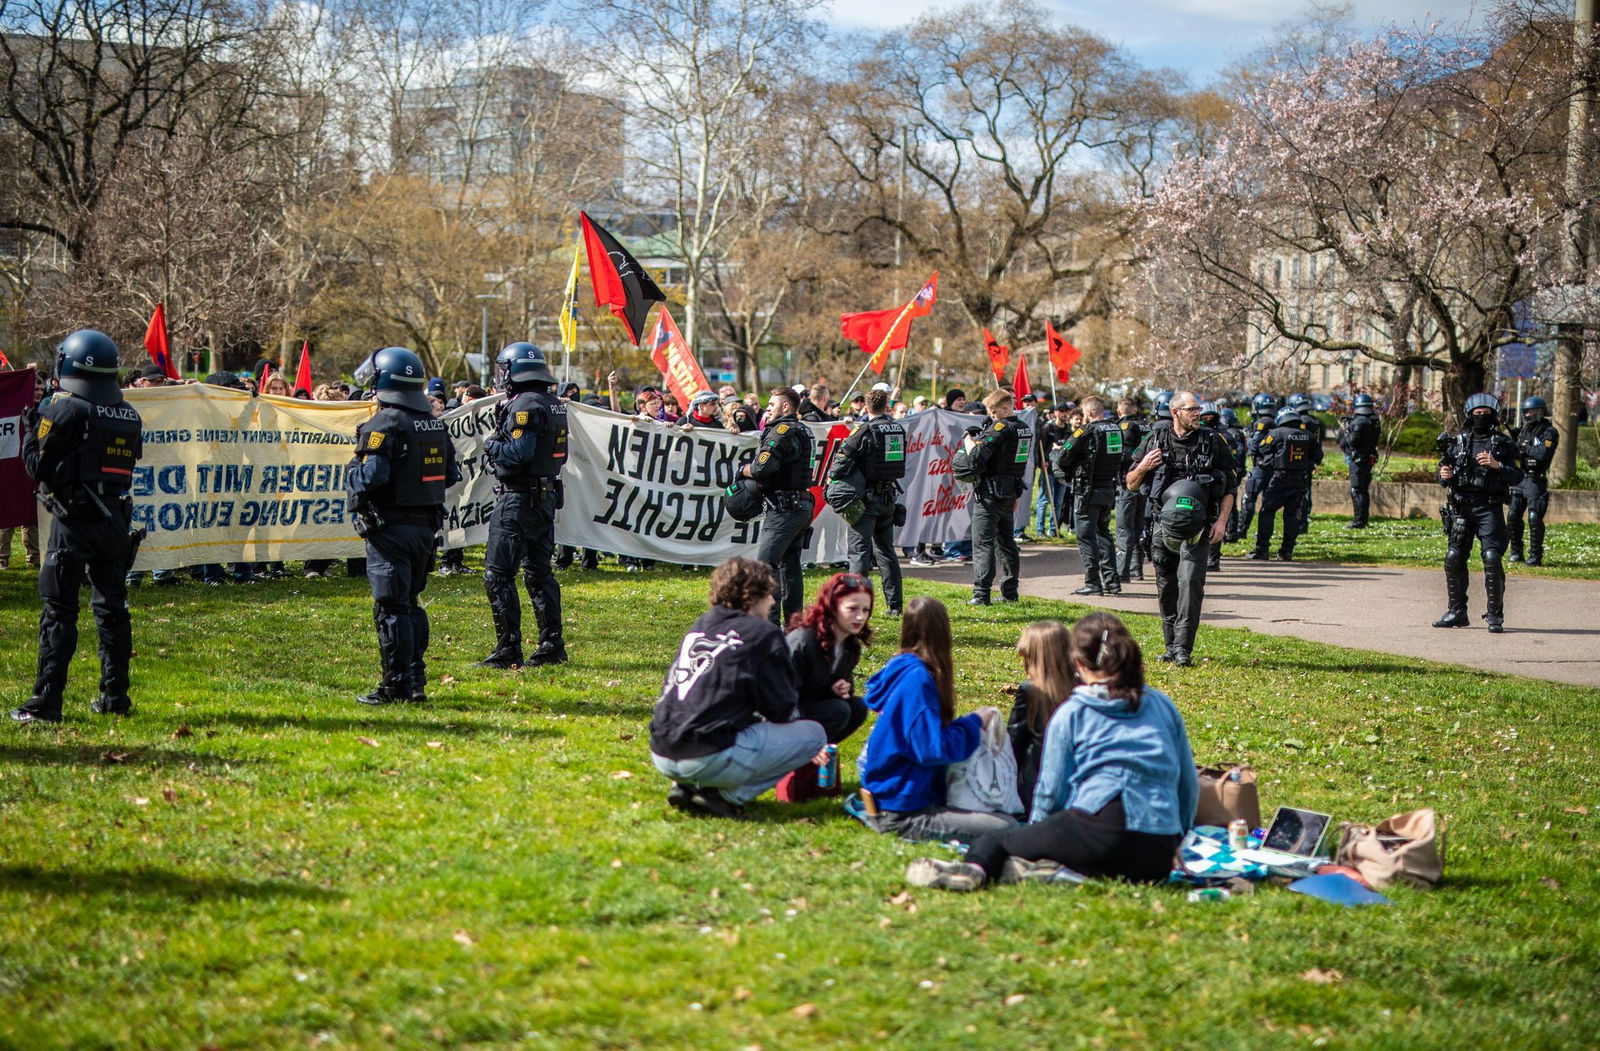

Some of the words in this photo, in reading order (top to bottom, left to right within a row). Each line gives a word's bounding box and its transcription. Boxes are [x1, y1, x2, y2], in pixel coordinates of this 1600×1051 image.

[85, 356, 94, 367] S
[405, 365, 413, 375] S
[593, 477, 726, 542] RECHTE
